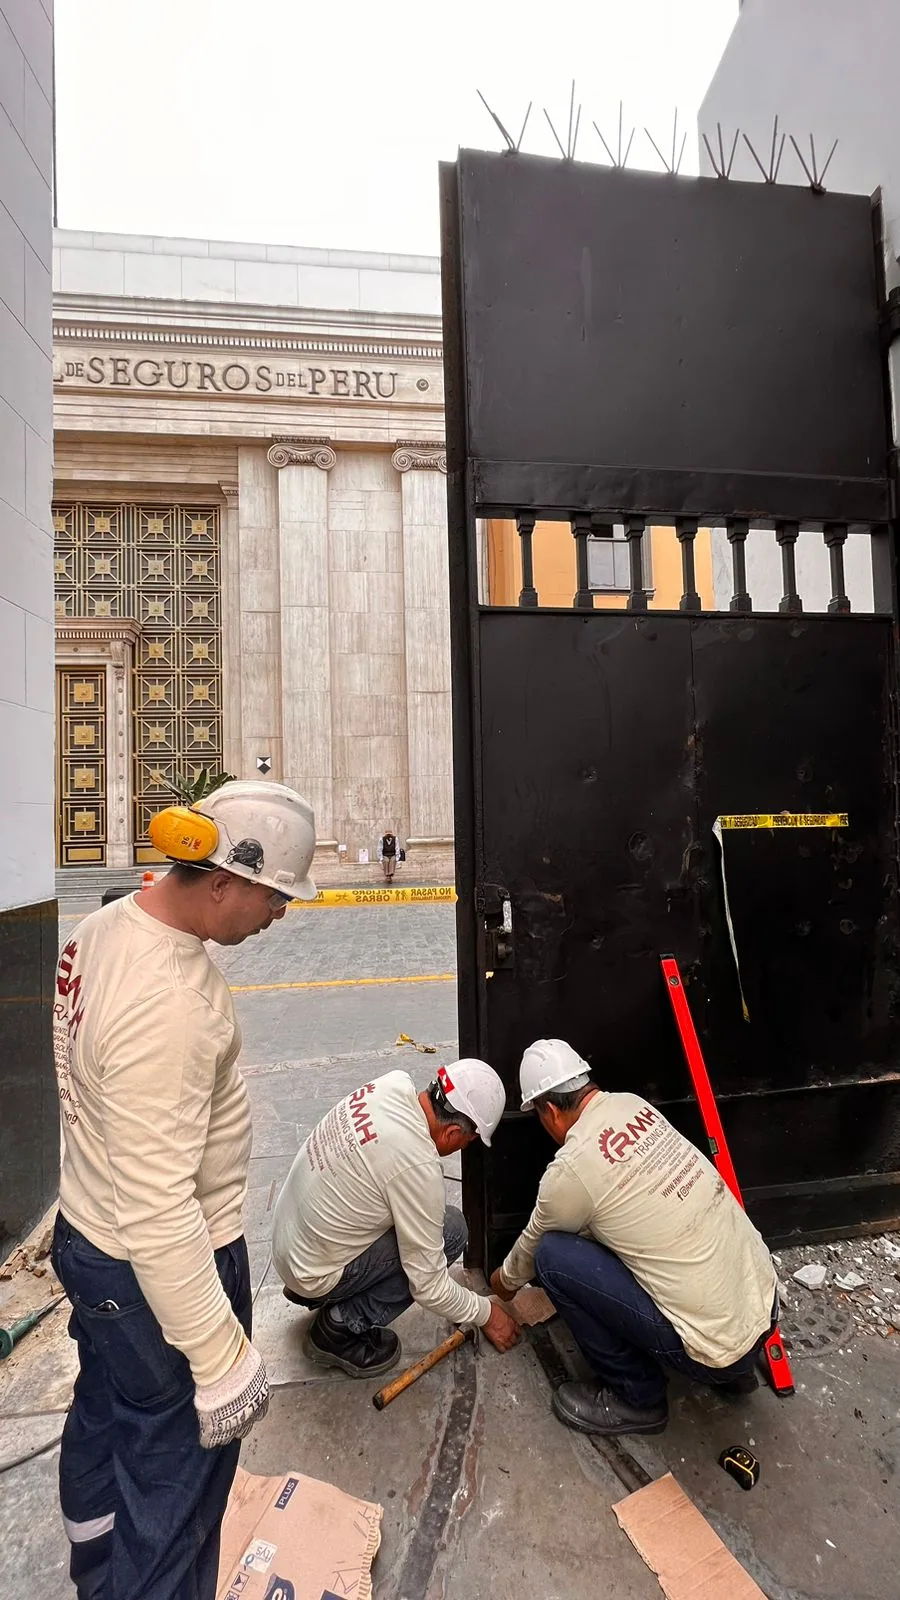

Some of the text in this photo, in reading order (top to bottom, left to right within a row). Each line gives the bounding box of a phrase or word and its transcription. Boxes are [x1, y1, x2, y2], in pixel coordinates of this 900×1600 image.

[65, 357, 398, 399] DE SEGUROS DEL PERU
[349, 1088, 378, 1146] RMH
[608, 1106, 660, 1158] RMH
[633, 1127, 664, 1158] TRADING
[217, 1380, 270, 1432] OYAL PLUS
[278, 1481, 296, 1506] PLUS
